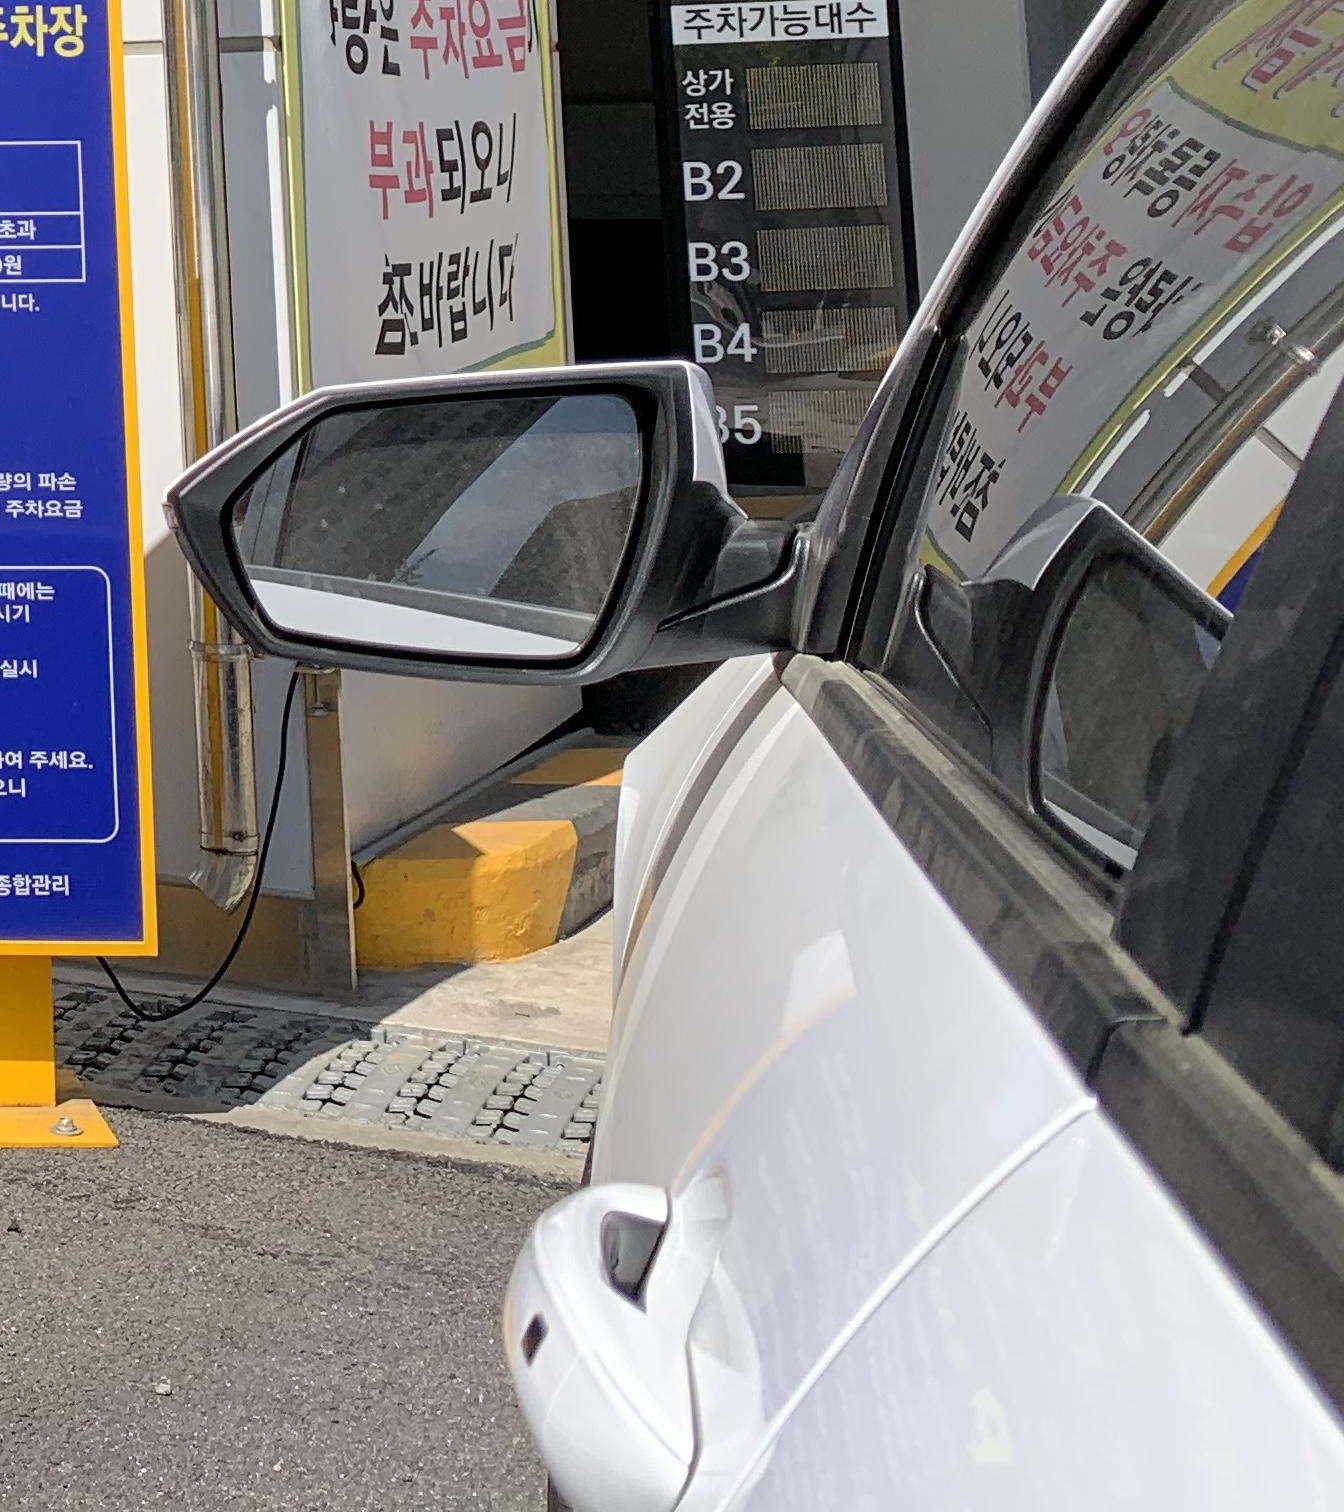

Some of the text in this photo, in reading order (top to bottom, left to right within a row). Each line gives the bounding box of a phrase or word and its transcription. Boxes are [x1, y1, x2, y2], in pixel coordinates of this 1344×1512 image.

[682, 2, 878, 40] 주차가능대수
[681, 68, 734, 98] 상가
[683, 101, 736, 130] 전용
[368, 112, 516, 220] 부과되오니
[683, 160, 746, 202] B2
[687, 241, 751, 283] B3
[692, 323, 758, 365] B4
[37, 472, 77, 492] 파손
[4, 499, 84, 519] 주차요금
[28, 750, 94, 770] 주세요.
